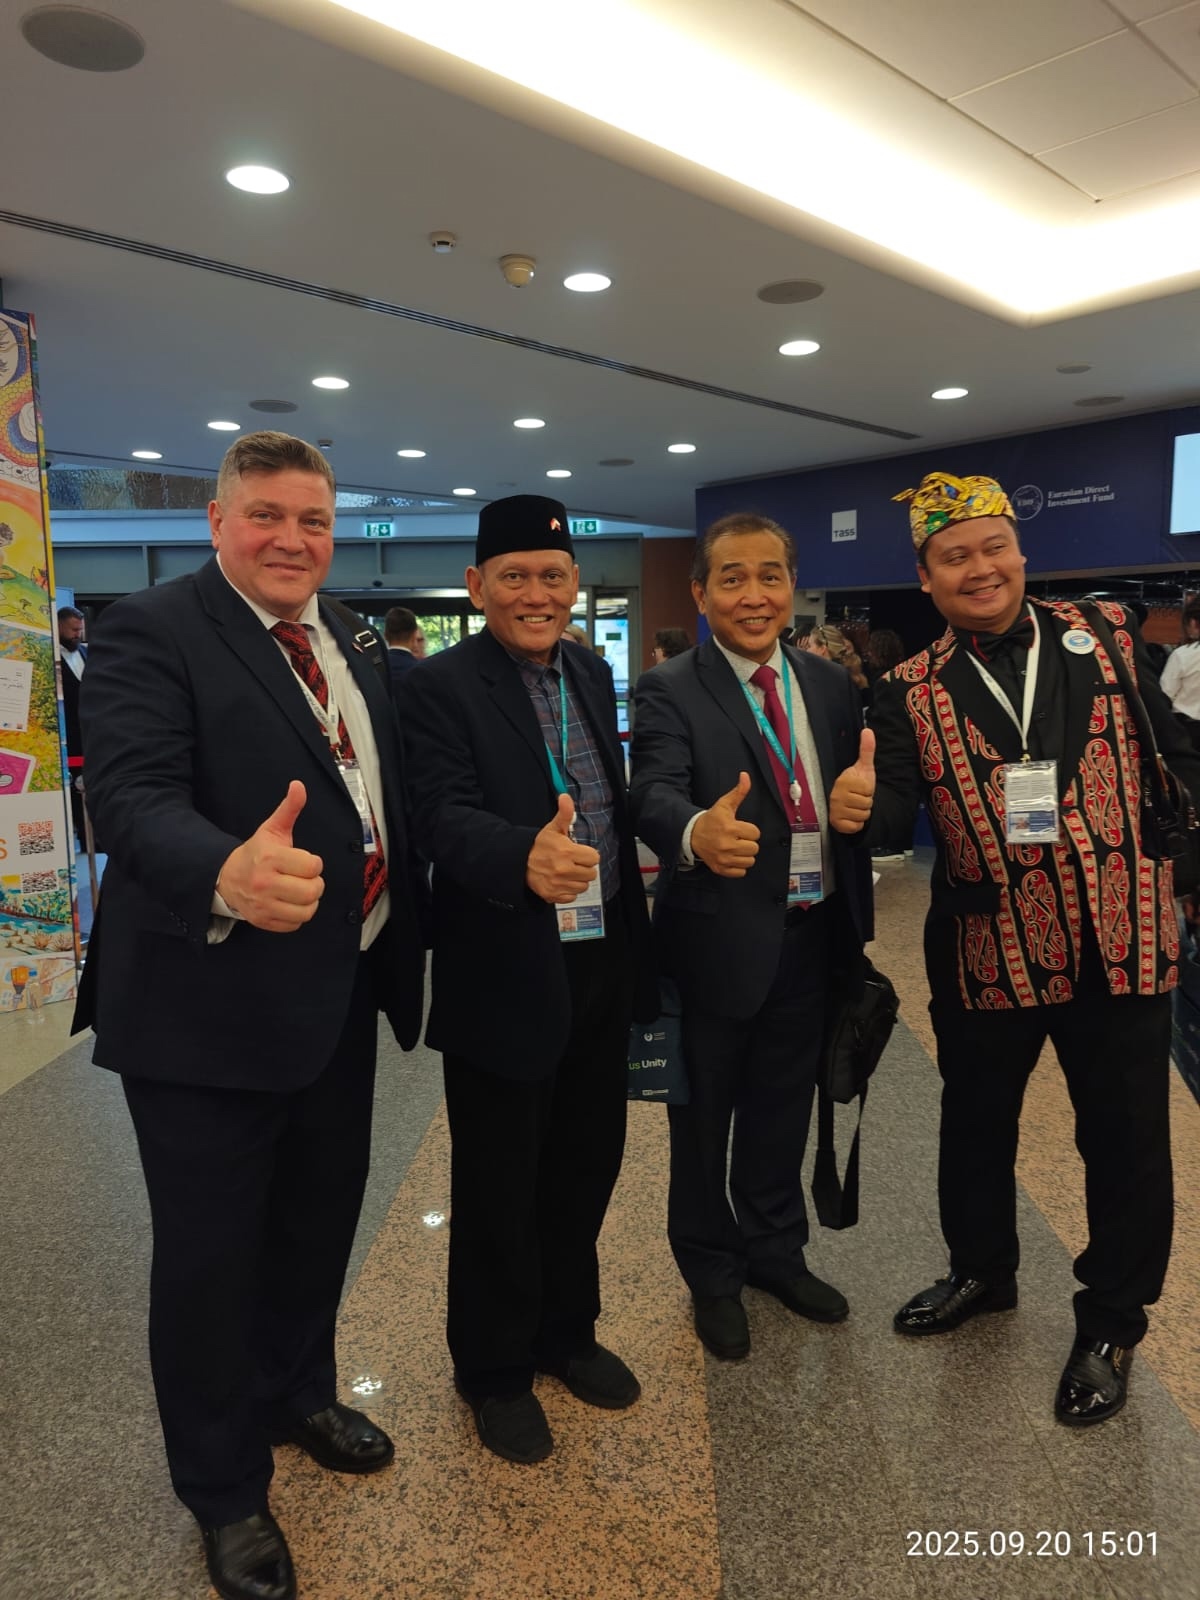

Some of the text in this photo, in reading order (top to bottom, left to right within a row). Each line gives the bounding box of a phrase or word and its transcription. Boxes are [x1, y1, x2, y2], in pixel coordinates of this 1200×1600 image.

[1047, 484, 1110, 499] Eurasian Direct
[1047, 496, 1091, 508] Investment
[1092, 492, 1115, 503] Fund
[641, 1058, 667, 1069] Unity
